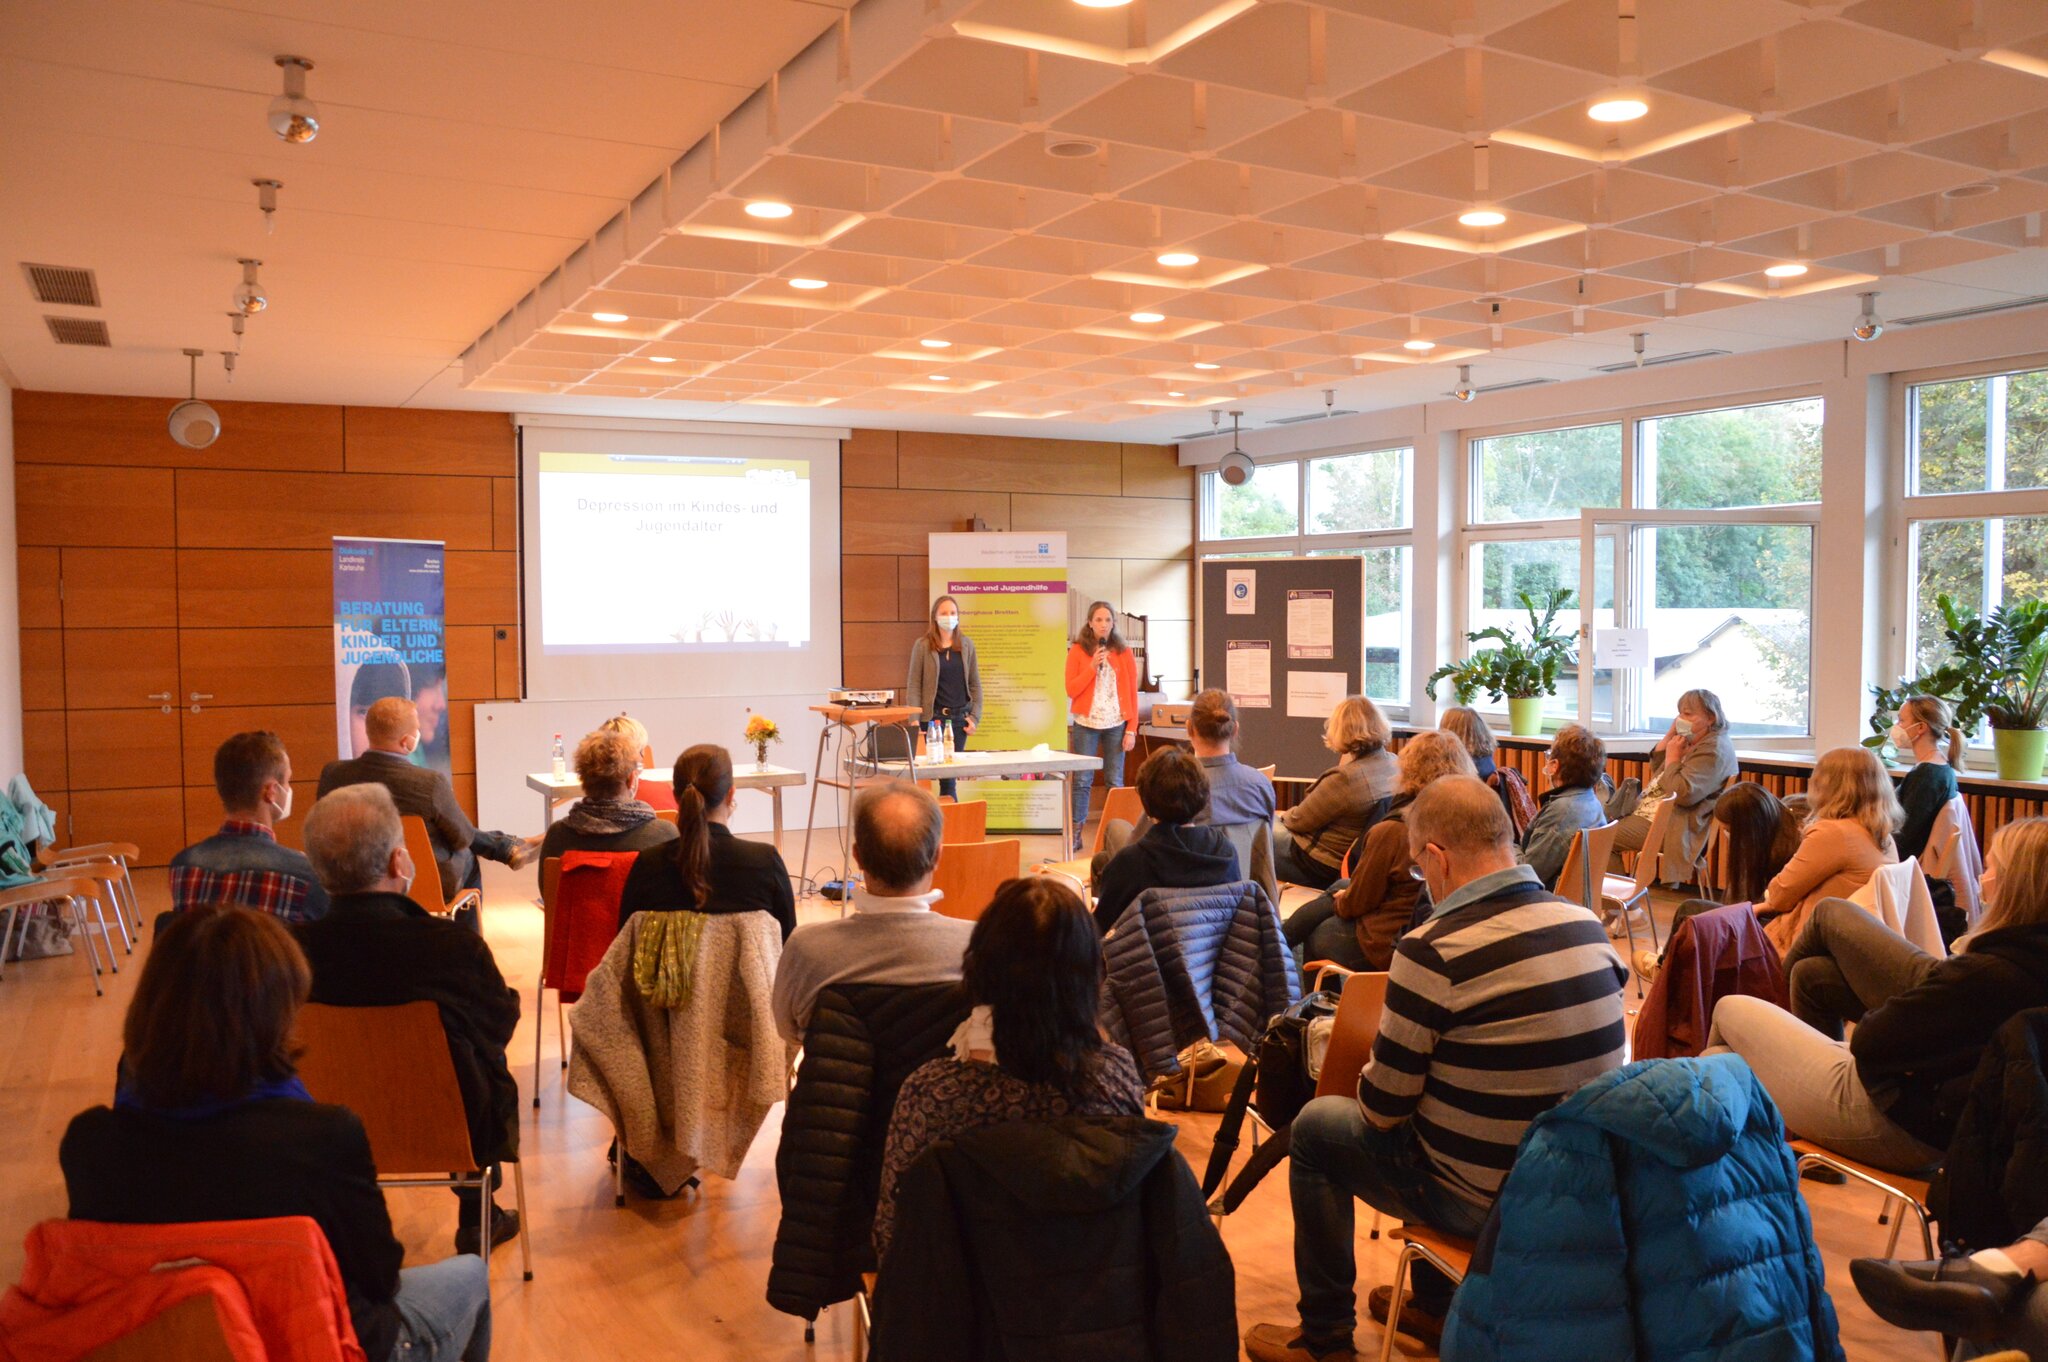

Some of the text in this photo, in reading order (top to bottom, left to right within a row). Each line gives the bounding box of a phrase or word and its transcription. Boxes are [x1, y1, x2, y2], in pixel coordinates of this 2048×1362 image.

[577, 498, 778, 514] Depression im Kindes- und
[636, 519, 723, 534] Jugendalter
[950, 584, 1049, 593] Kinder- und Jugendhilfe
[341, 601, 425, 615] BERATUNG
[382, 618, 442, 634] ELTERN,
[341, 634, 438, 648] KINDER UND
[341, 649, 444, 664] JUGENDLICHE
